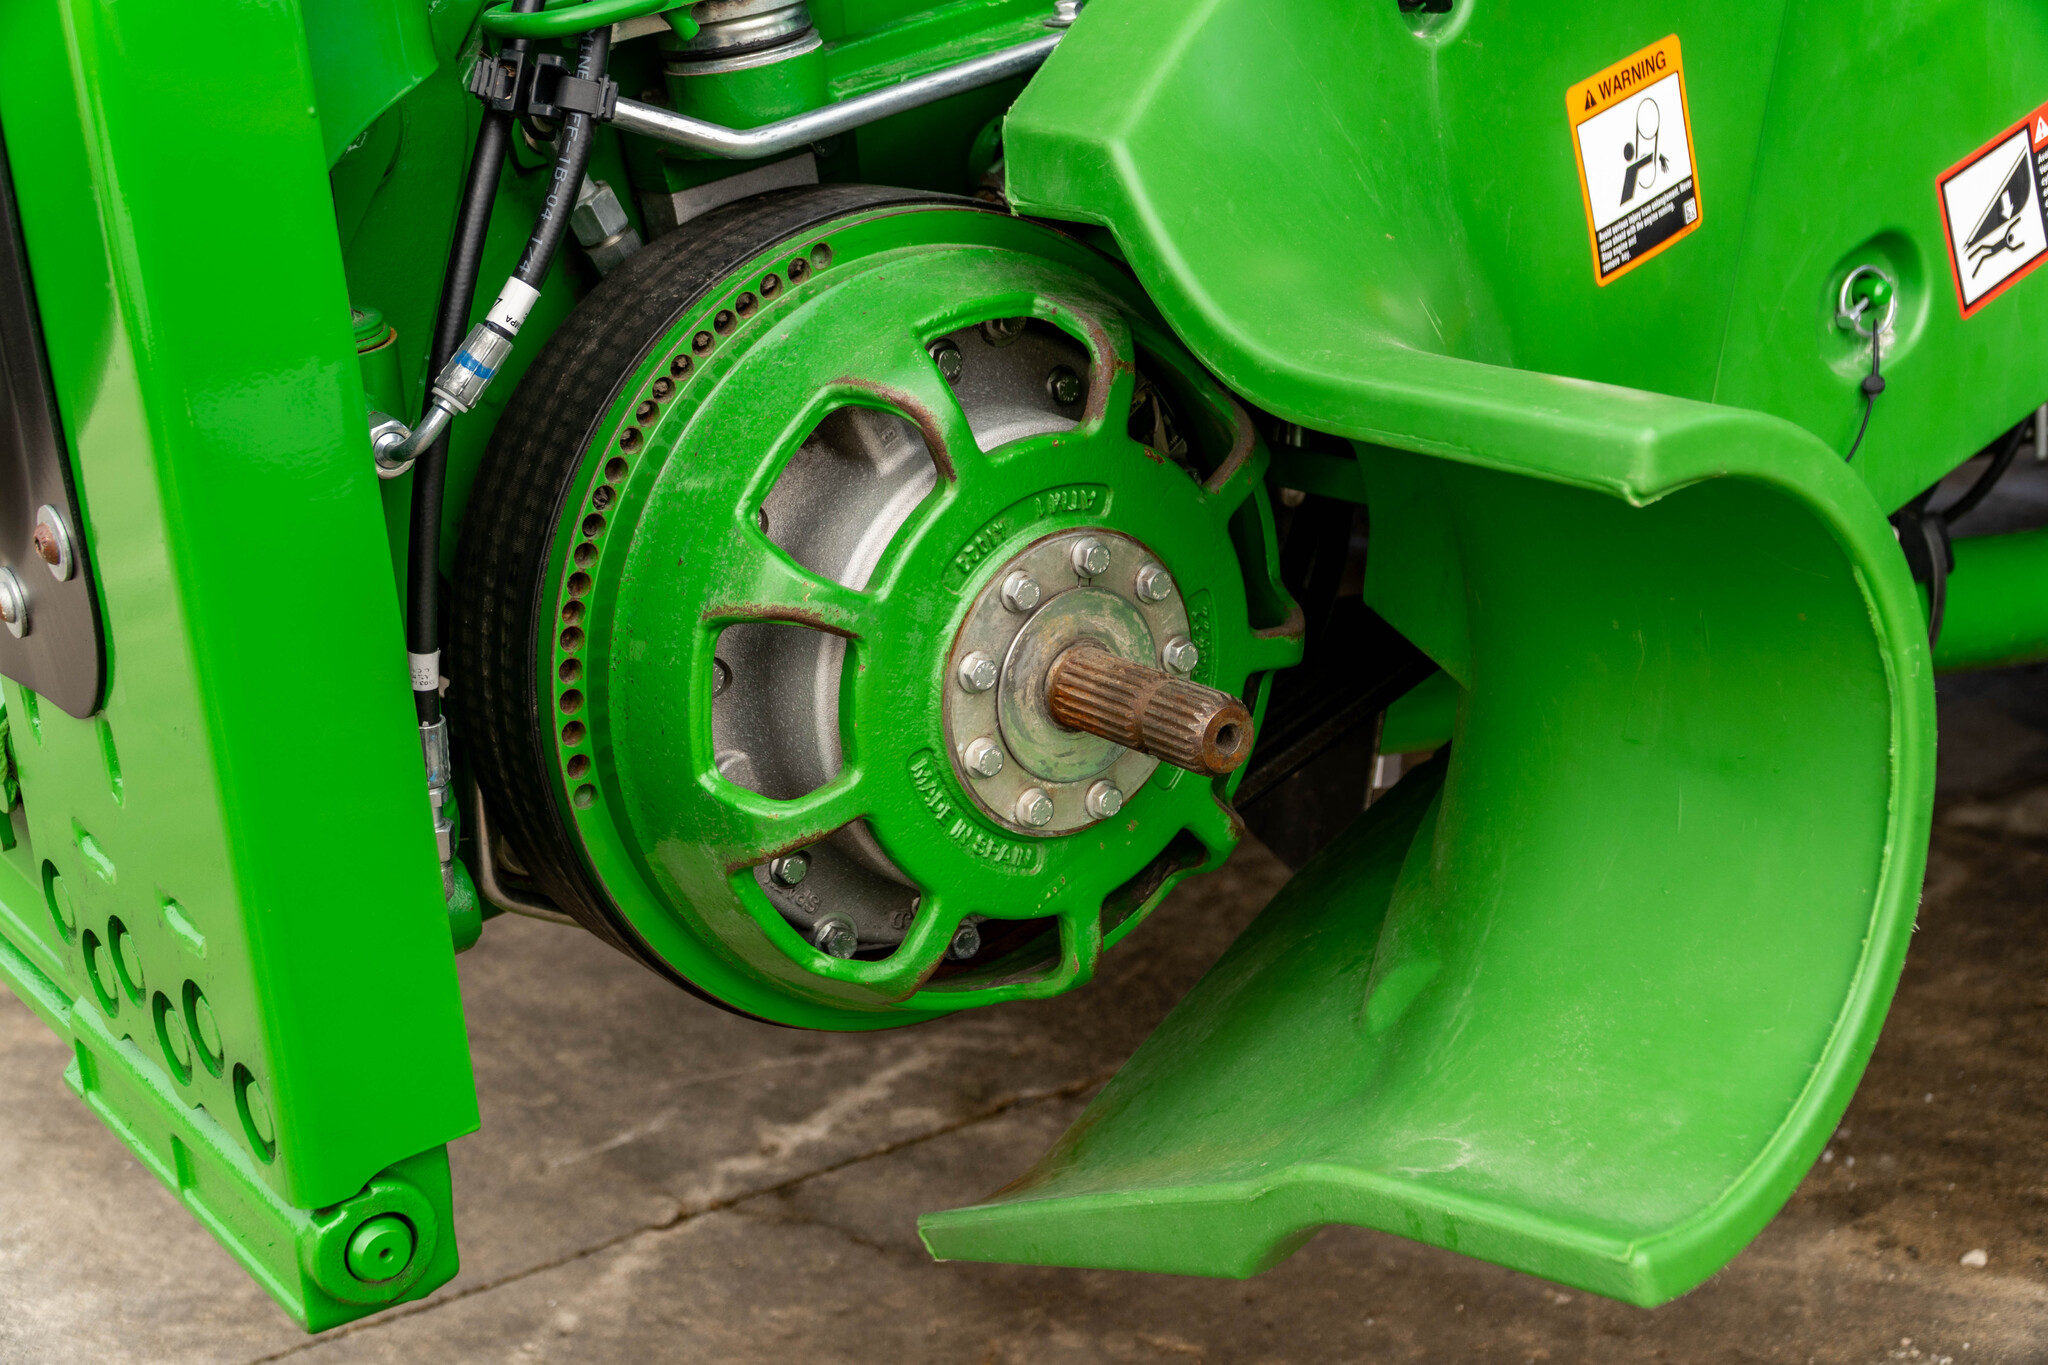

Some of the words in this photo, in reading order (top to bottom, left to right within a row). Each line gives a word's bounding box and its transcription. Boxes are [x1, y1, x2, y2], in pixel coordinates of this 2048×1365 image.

[1598, 50, 1667, 101] WARNING
[1599, 226, 1612, 243] Avoid
[1611, 217, 1629, 236] serious
[1628, 210, 1642, 226] injury
[1641, 203, 1653, 218] from
[1635, 219, 1644, 232] the
[1643, 211, 1659, 228] engine
[1612, 240, 1629, 257] engine
[1602, 255, 1621, 273] remove
[911, 758, 955, 827] MADE
[950, 818, 974, 845] IN
[972, 833, 1033, 867] SPAIN
